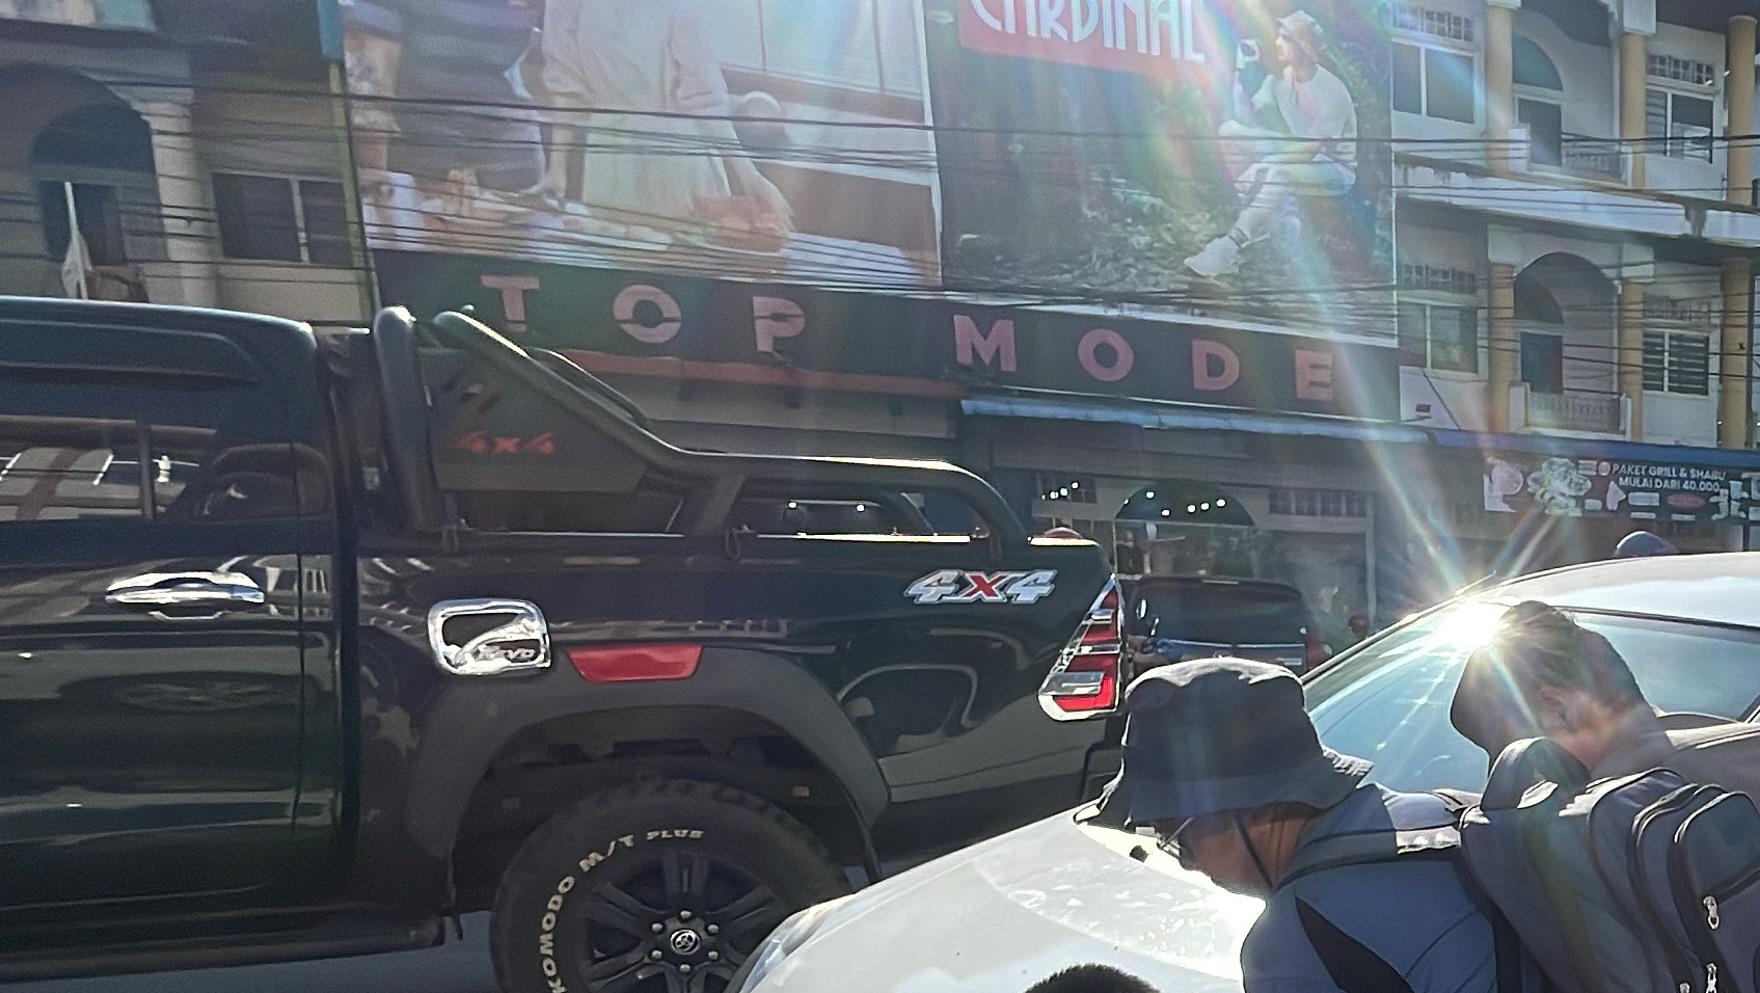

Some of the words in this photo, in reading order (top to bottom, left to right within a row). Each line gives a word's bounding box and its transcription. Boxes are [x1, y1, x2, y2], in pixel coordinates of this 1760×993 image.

[481, 274, 806, 353] TOP
[953, 314, 1333, 401] MODE
[1611, 463, 1646, 477] PAKET
[1648, 466, 1677, 478] GRILL
[1618, 476, 1653, 489] MULAI
[1655, 479, 1681, 490] DARI
[579, 834, 635, 872] M/T
[646, 829, 705, 841] PLUS
